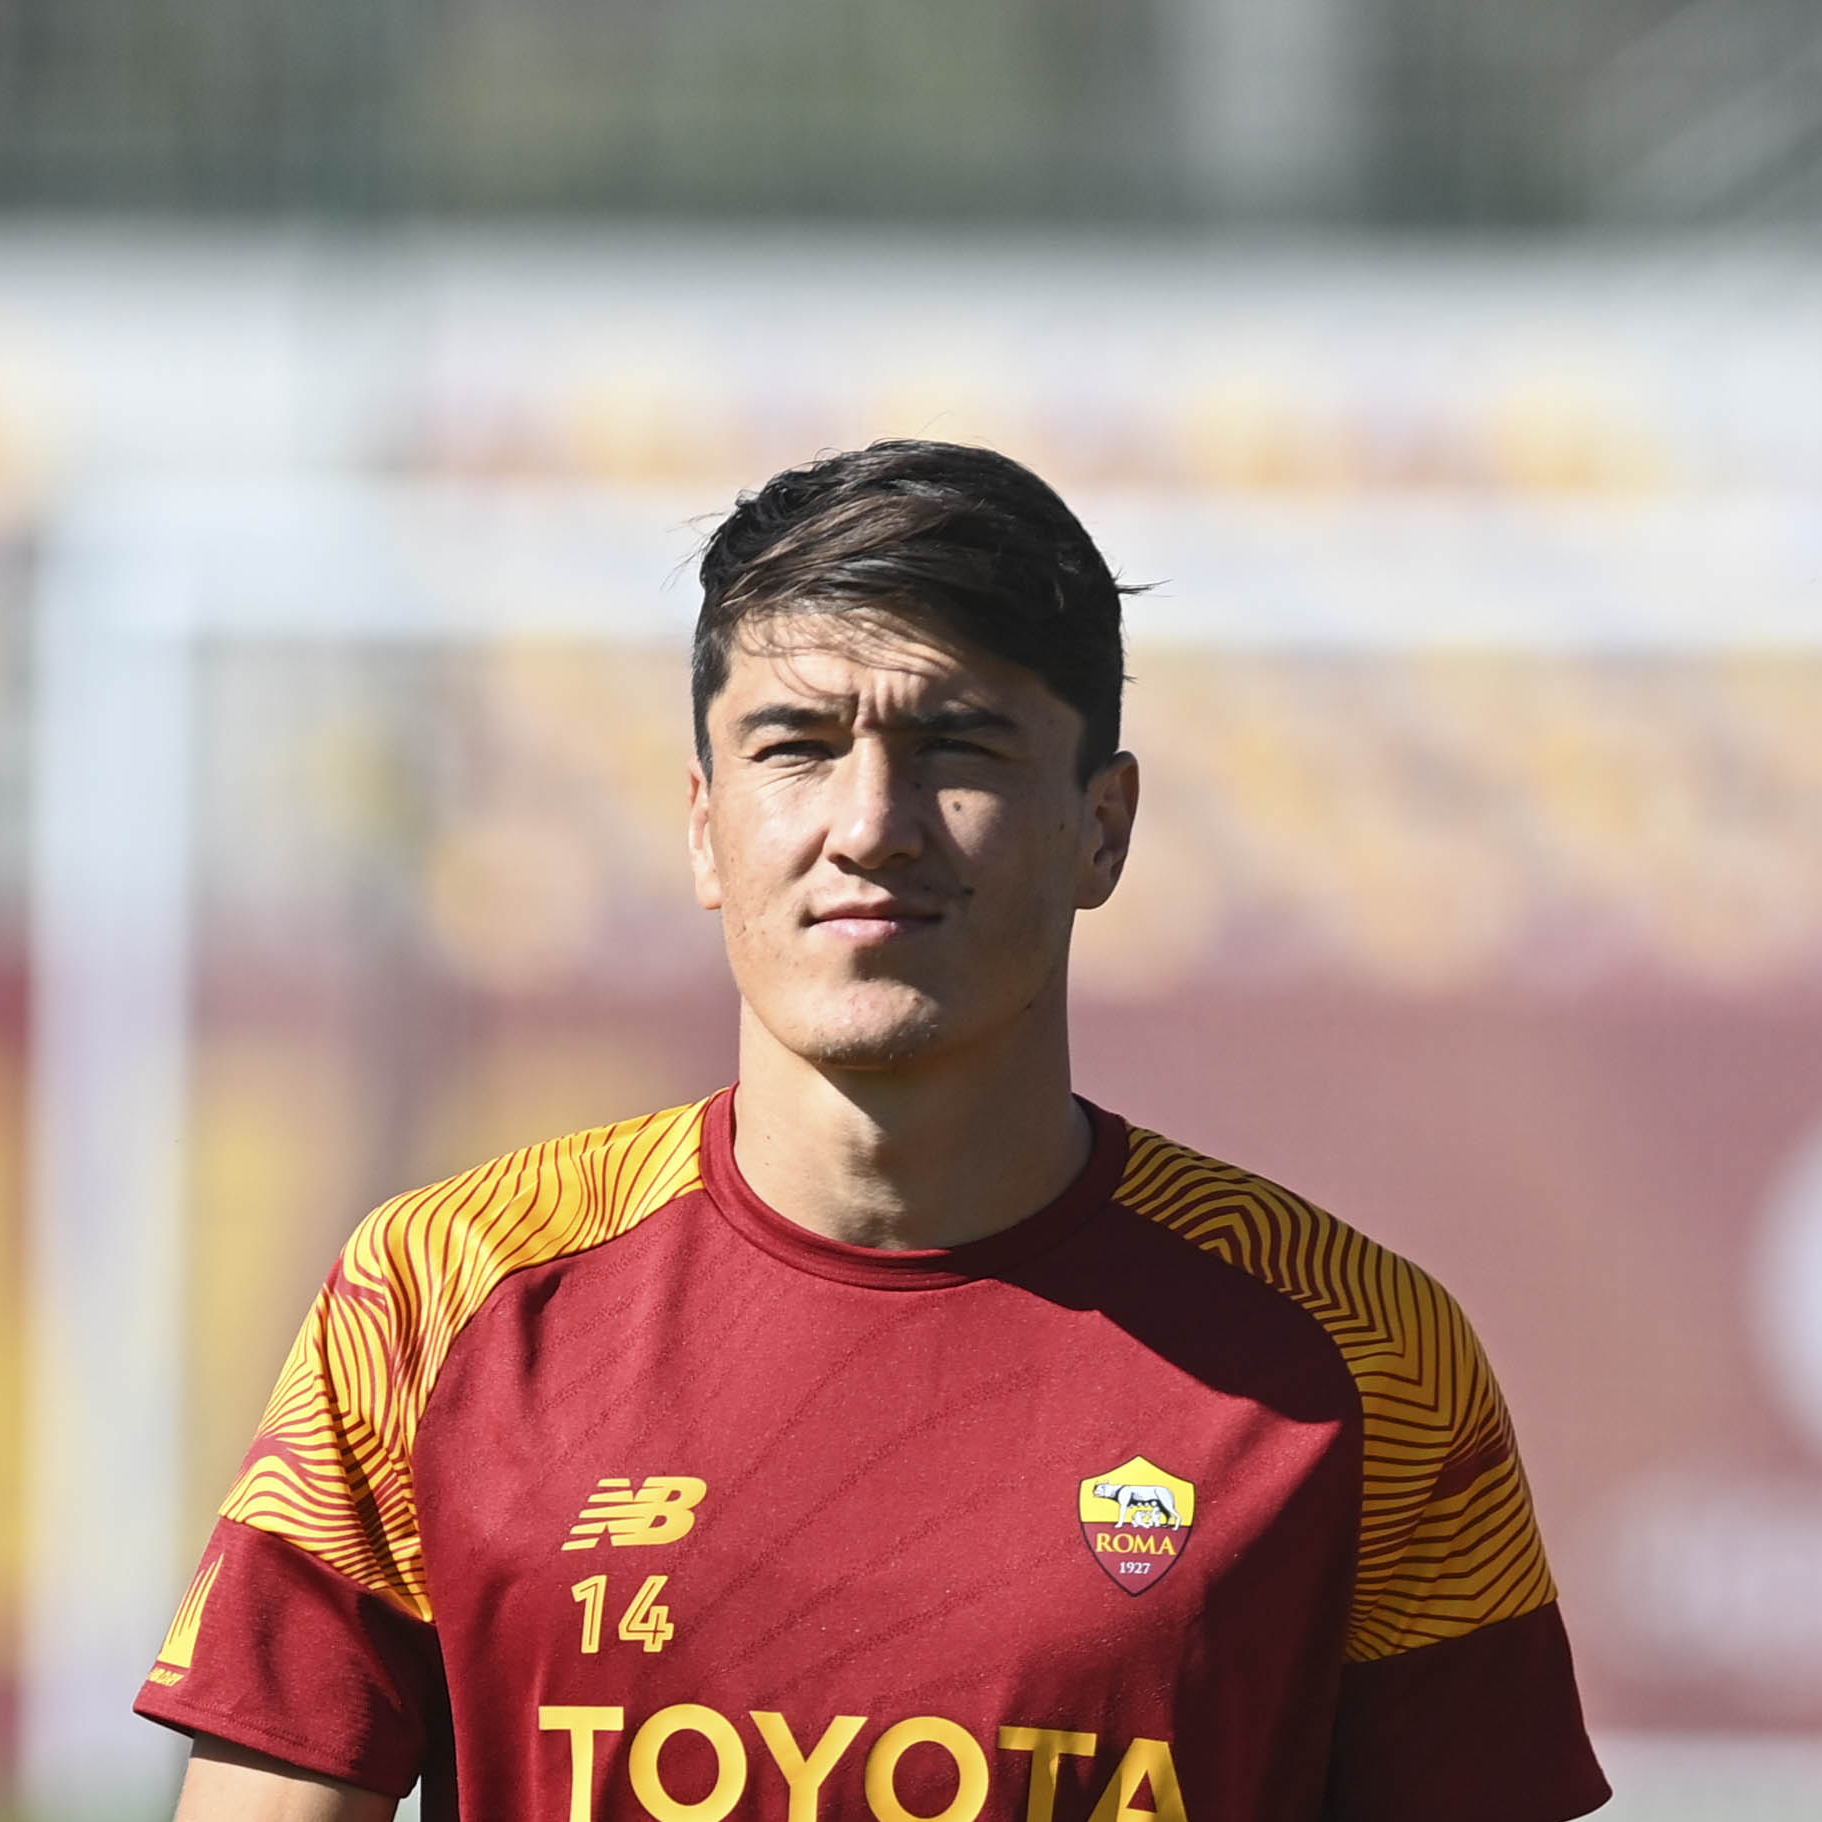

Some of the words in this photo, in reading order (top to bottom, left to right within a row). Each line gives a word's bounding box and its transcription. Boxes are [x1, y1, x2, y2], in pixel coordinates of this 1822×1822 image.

[1095, 1532, 1177, 1556] ROMA
[1119, 1561, 1151, 1575] 1927
[571, 1575, 674, 1654] 14
